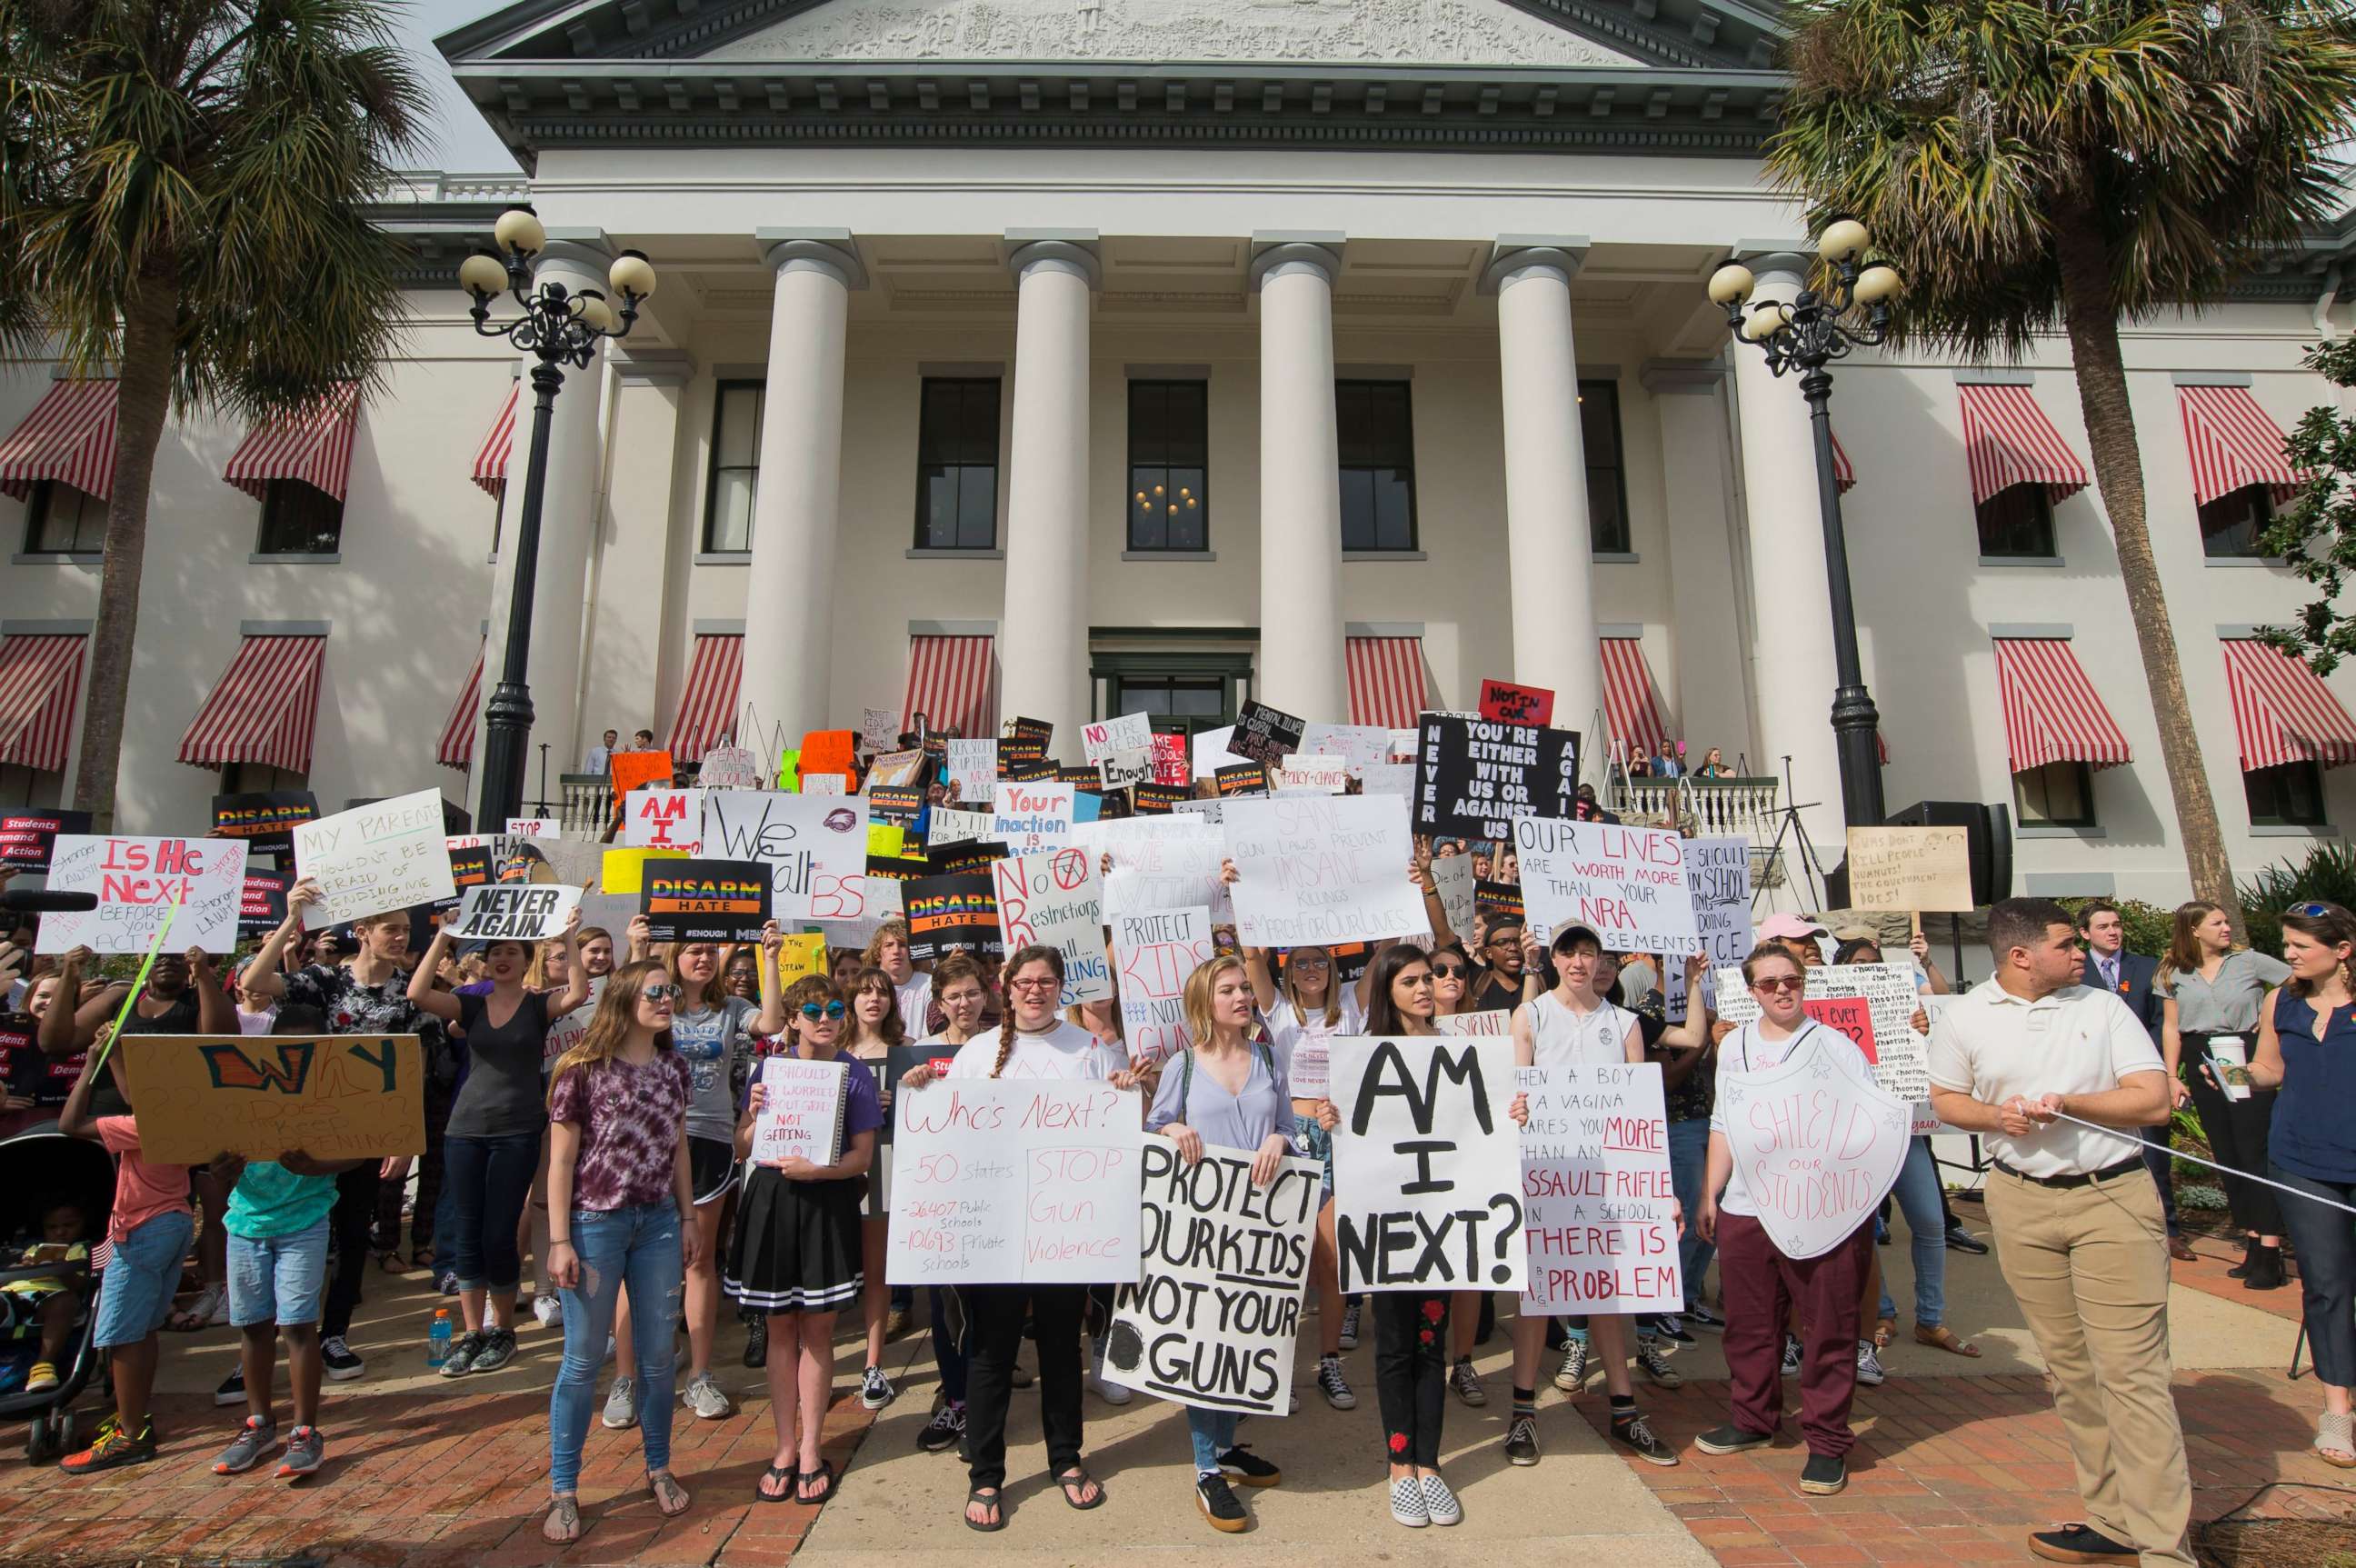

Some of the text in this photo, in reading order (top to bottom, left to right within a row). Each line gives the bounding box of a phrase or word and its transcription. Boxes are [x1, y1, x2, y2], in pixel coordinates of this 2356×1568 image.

[1491, 686, 1539, 707] NOT IN
[1086, 725, 1108, 744] NO
[1465, 721, 1539, 746] YOU'RE
[1000, 744, 1042, 753] DISARM
[1468, 741, 1538, 766] EITHER
[1103, 757, 1155, 784] Enough
[1219, 770, 1263, 783] DISARM
[1422, 724, 1442, 823] NEVER
[1476, 761, 1523, 784] WITH
[873, 792, 919, 800] DISARM
[1007, 788, 1067, 814] Your
[1138, 790, 1185, 801] DISARM
[1468, 780, 1529, 804] US OR
[218, 805, 312, 826] DISARM
[640, 795, 686, 819] AM
[1274, 800, 1352, 836] SANE
[1453, 798, 1538, 821] AGAINST
[7, 819, 56, 831] Students
[243, 823, 290, 834] HATE
[303, 803, 442, 858] MY PARENTS
[511, 821, 541, 837] STOP
[651, 819, 674, 844] I
[714, 795, 797, 859] We
[994, 815, 1066, 834] inaction
[1483, 821, 1509, 839] US
[0, 832, 35, 843] emand
[931, 831, 949, 843] FOR
[1026, 833, 1040, 847] is
[1236, 829, 1389, 858] GUN LAWS PREVENT
[1519, 821, 1682, 865] OUR LIVES
[5, 847, 44, 857] Action
[100, 839, 150, 872] Is
[400, 842, 428, 859] BE
[1851, 848, 1925, 867] KILL PEOPLE
[392, 863, 412, 877] OF
[1273, 850, 1372, 892] INSANE
[1453, 866, 1466, 882] of
[1523, 858, 1682, 886] ARE WORTH MORE
[102, 874, 195, 905] Next
[243, 878, 280, 890] tudents
[404, 877, 431, 892] ME
[652, 879, 762, 900] DISARM
[1548, 879, 1658, 904] THAN YOUR
[1704, 868, 1750, 900] SCHOOL
[1852, 881, 1873, 890] THE
[327, 892, 432, 923] TO SCHOOL
[471, 889, 560, 914] NEVER
[678, 901, 732, 912] HATE
[810, 874, 864, 918] BS
[1296, 888, 1349, 907] KILLINGS
[1860, 888, 1900, 906] DOES!
[100, 905, 171, 922] BEFORE
[931, 914, 979, 927] HATE
[1580, 897, 1637, 931] NRA
[1697, 912, 1732, 933] DOING
[461, 914, 545, 937] AGAIN.
[685, 929, 728, 939] #ENOUGH
[1123, 913, 1193, 945] PROTECT
[95, 934, 143, 952] ACT
[1829, 1005, 1862, 1025] ever
[1569, 1067, 1635, 1085] A BOY
[1352, 1041, 1495, 1136] AM
[905, 1090, 1119, 1134] Who's Next?
[1535, 1094, 1624, 1110] A VAGINA
[776, 1114, 805, 1126] NOT
[1580, 1115, 1664, 1150] YOU MORE
[756, 1143, 819, 1160] SHOT
[1577, 1144, 1602, 1161] AN
[1036, 1149, 1123, 1185] STOP
[1393, 1141, 1458, 1195] I
[1789, 1157, 1822, 1173] OUR
[1142, 1144, 1321, 1227] PROTECT
[1616, 1170, 1673, 1199] RIFLE
[1754, 1158, 1874, 1222] STUDENTS
[960, 1199, 991, 1214] Public
[1030, 1191, 1093, 1223] Gun
[1525, 1206, 1542, 1223] IN
[1574, 1203, 1586, 1220] A
[962, 1234, 1005, 1252] Private
[1027, 1233, 1121, 1264] Violence
[1216, 1226, 1306, 1278] KIDS
[1337, 1193, 1522, 1293] NEXT?
[1526, 1226, 1666, 1256] THERE IS
[1548, 1266, 1680, 1303] PROBLEM.
[1117, 1273, 1300, 1337] NOT YOUR
[1149, 1333, 1279, 1401] GUNS
